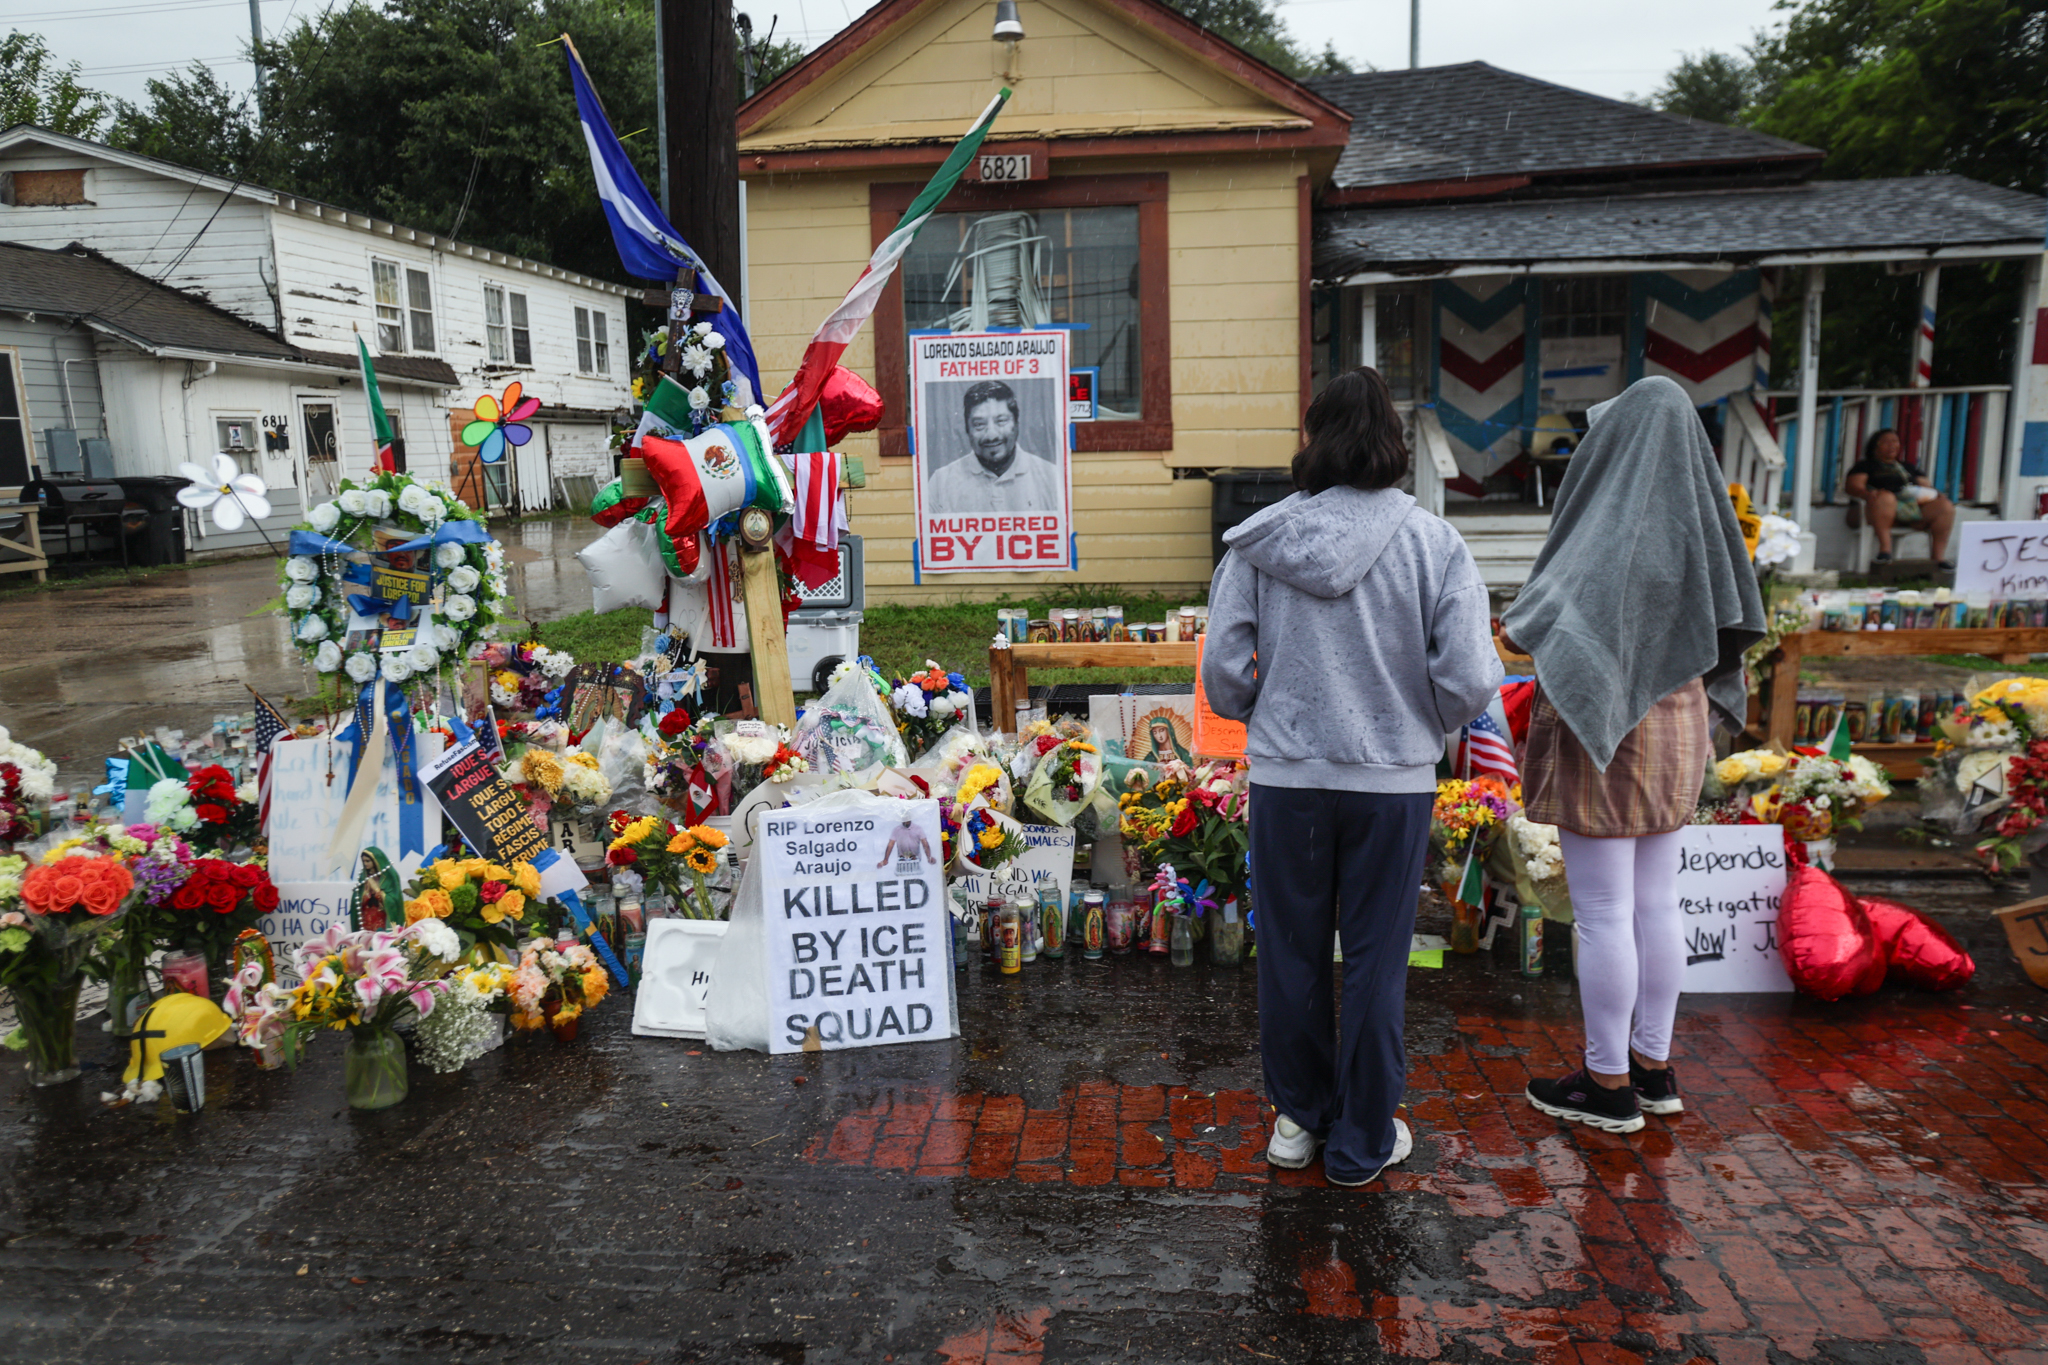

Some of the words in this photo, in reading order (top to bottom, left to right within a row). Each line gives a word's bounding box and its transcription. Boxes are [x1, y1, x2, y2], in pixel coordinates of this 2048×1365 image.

[981, 156, 1030, 181] 6821
[924, 343, 967, 359] LORENZO
[969, 341, 1013, 357] SALGADO
[1016, 340, 1056, 356] ARAUJO
[940, 361, 1000, 377] FATHER
[1004, 361, 1025, 375] OF
[1029, 360, 1040, 374] 3
[262, 415, 287, 428] 6811
[929, 516, 1058, 533] MURDERED
[930, 535, 986, 562] BY
[996, 533, 1060, 560] ICE
[376, 575, 409, 589] JUSTICE
[411, 580, 427, 593] FOR
[446, 764, 494, 801] LARGUE
[476, 790, 517, 821] LARGU
[484, 807, 518, 832] TODO
[767, 821, 797, 836] RIP
[803, 820, 874, 834] Lorenzo
[498, 827, 540, 860] FASCIS
[786, 839, 857, 857] Salgado
[1025, 835, 1073, 849] NIMALES!
[793, 859, 852, 876] Araujo
[337, 897, 351, 916] H
[783, 878, 929, 919] KILLED
[283, 918, 304, 937] HA
[792, 929, 847, 963] BY
[860, 923, 927, 958] ICE
[788, 958, 925, 999] DEATH
[785, 1003, 933, 1046] SQUAD
